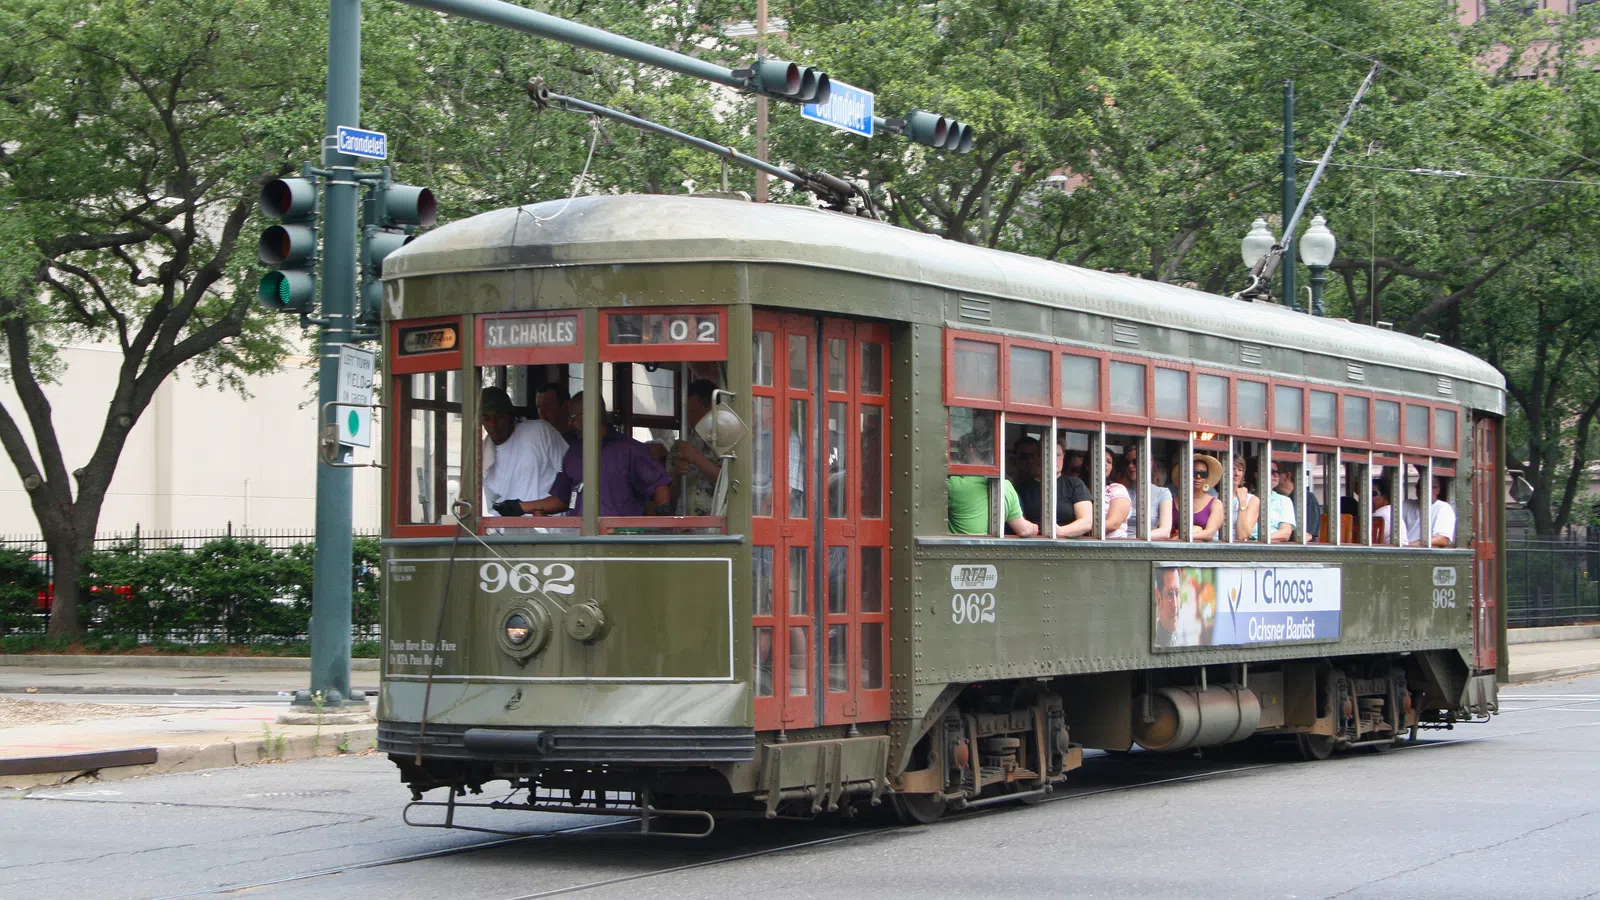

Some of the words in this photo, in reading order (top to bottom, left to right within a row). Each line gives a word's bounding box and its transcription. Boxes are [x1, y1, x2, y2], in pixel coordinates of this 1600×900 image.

[340, 130, 384, 155] Carondelet
[487, 325, 507, 346] ST.
[510, 321, 574, 345] CHARLES
[343, 354, 356, 368] LEFT
[356, 357, 371, 370] TURN
[346, 372, 364, 389] YIELD
[479, 562, 575, 595] 962
[960, 567, 988, 584] RTA
[1254, 570, 1258, 604] I
[1262, 567, 1313, 604] Choose
[952, 592, 996, 624] 962
[1432, 588, 1456, 609] 962
[1248, 616, 1285, 641] Ochsner
[1286, 616, 1315, 640] Baptist
[405, 639, 420, 651] Have
[441, 639, 457, 652] Fare
[410, 653, 423, 665] Pass
